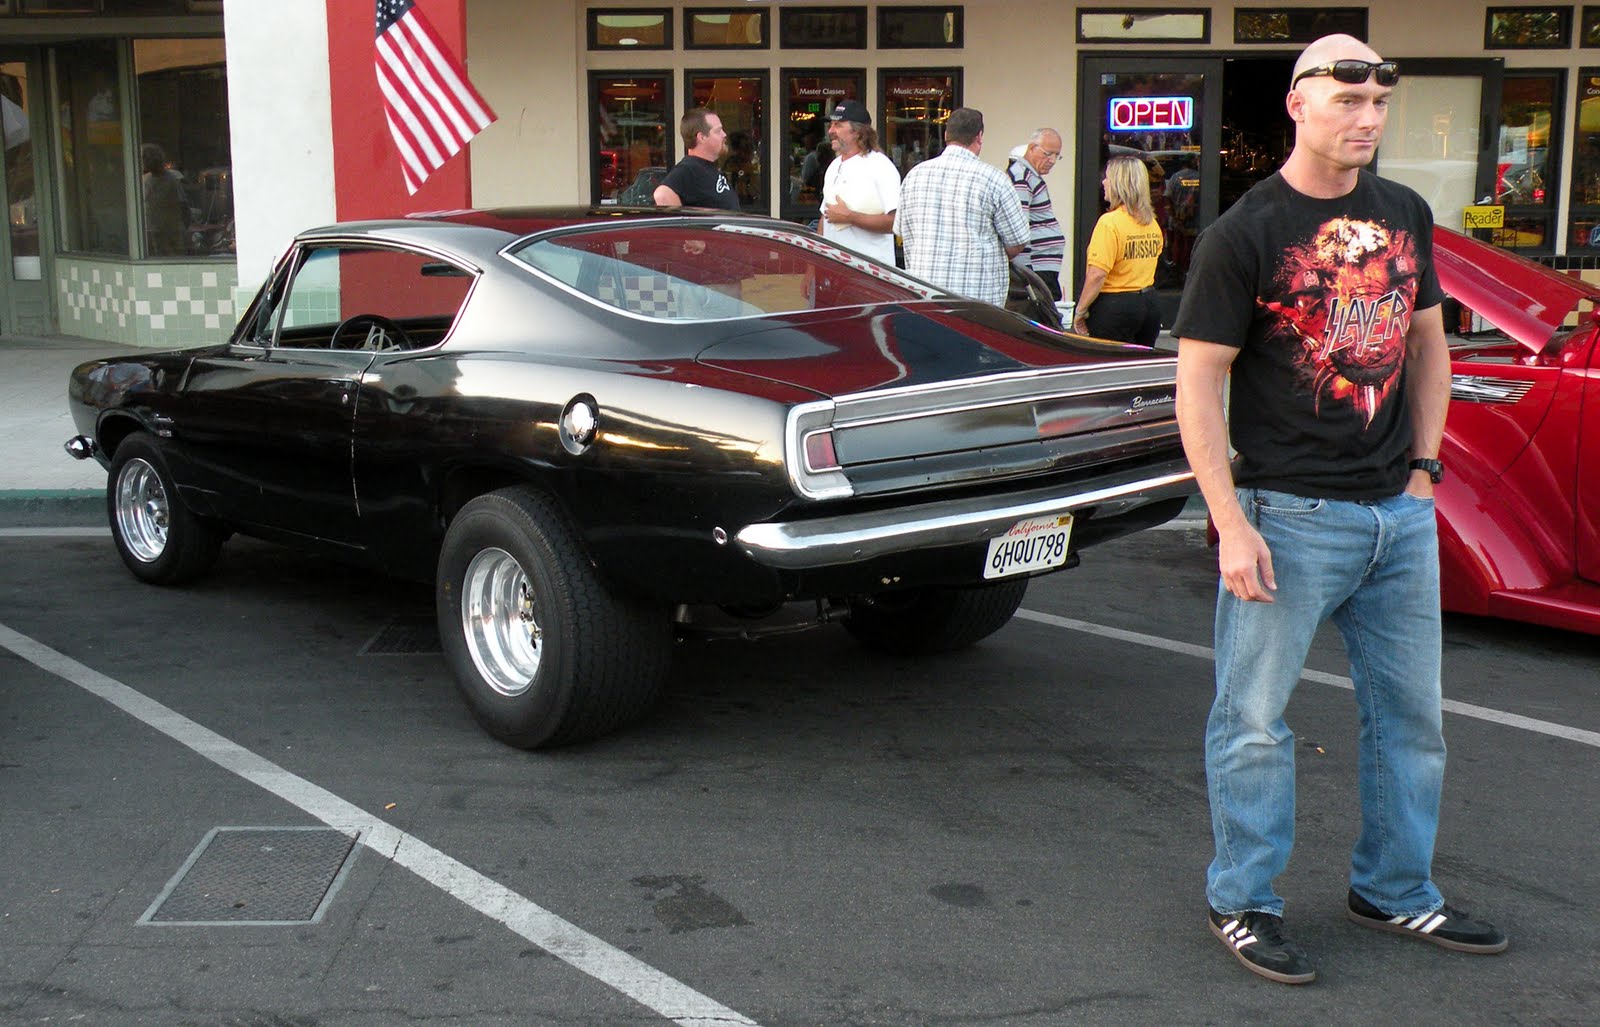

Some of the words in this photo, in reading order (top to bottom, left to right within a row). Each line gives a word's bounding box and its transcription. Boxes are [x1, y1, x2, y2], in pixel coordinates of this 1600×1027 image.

[799, 88, 821, 96] Master
[822, 88, 846, 96] Classes
[914, 87, 944, 97] Academy
[808, 103, 820, 112] EXIT
[1114, 100, 1189, 127] OPEN
[1465, 209, 1503, 225] Reader
[1320, 289, 1409, 360] SLAYER
[1132, 395, 1176, 408] Barracuda
[1008, 520, 1058, 537] California
[992, 532, 1066, 569] 6HQU798
